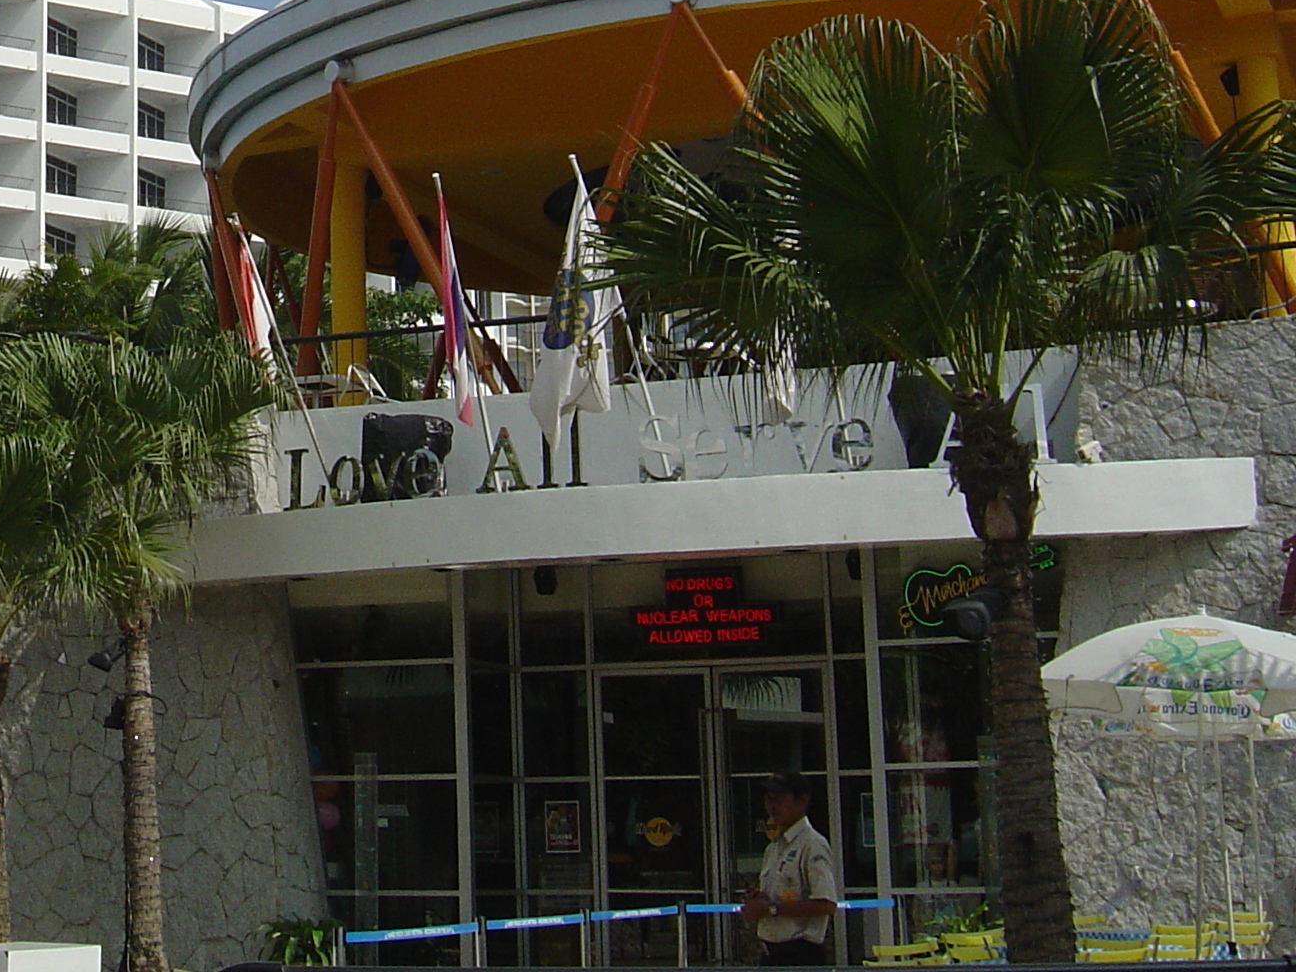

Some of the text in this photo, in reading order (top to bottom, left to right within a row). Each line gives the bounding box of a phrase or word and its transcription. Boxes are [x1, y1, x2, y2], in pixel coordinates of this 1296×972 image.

[283, 448, 448, 512] Love
[475, 406, 589, 494] All
[638, 413, 874, 484] Serve
[665, 577, 734, 592] NO DRUGS
[692, 593, 714, 608] OR
[636, 609, 772, 626] NUCLEAR WEAPONS
[649, 627, 760, 644] ALLOWED INSIDE
